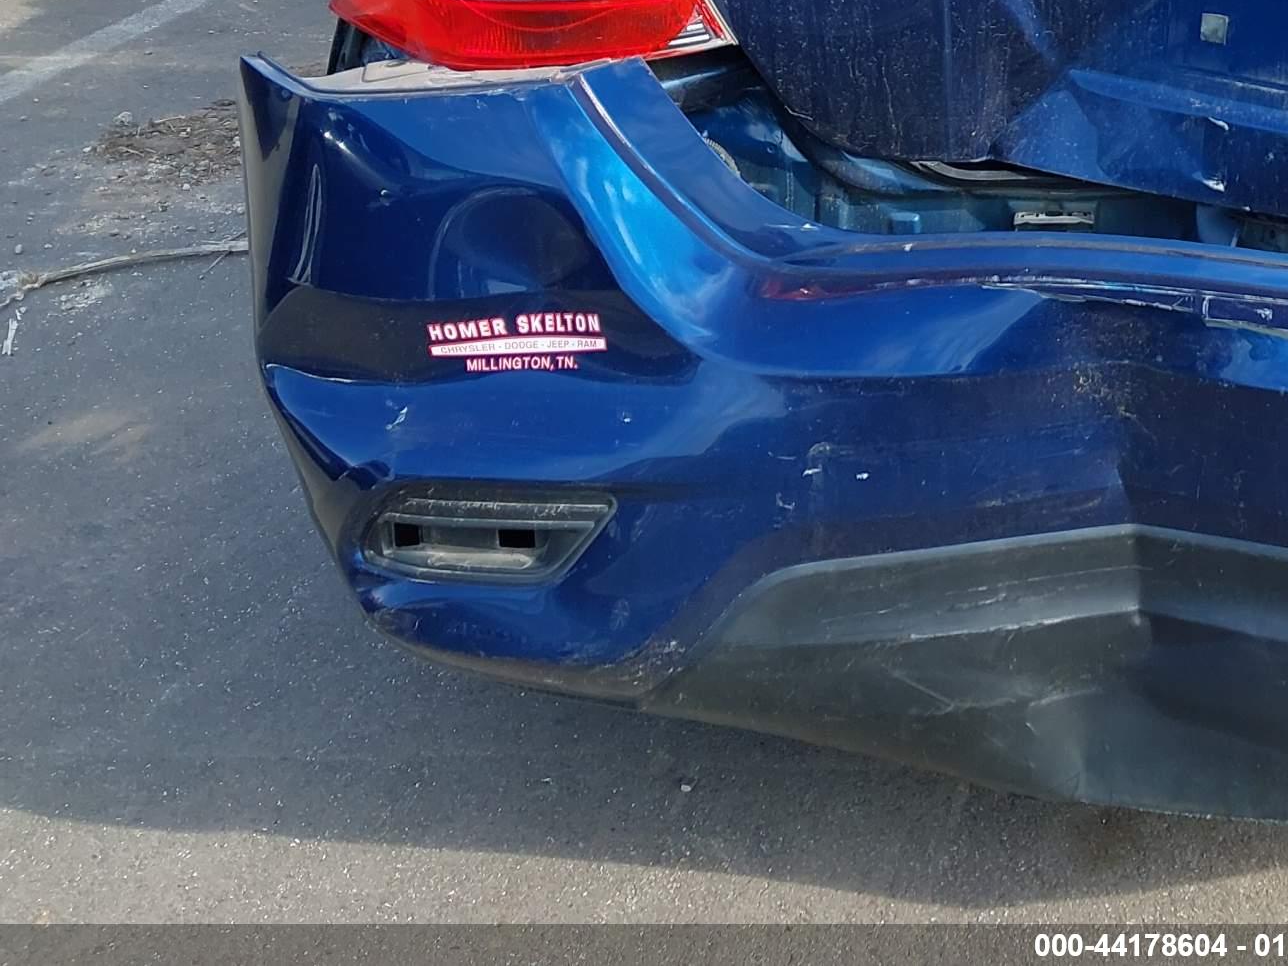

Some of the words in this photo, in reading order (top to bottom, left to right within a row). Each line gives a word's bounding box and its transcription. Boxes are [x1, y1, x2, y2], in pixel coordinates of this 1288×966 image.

[427, 317, 508, 341] HOMER
[515, 312, 601, 334] SKELTON
[440, 343, 496, 354] CHRYSLER
[504, 340, 539, 350] DODGE
[546, 339, 570, 349] JEEP
[576, 338, 598, 348] RAM
[466, 356, 555, 372] MILLINGTON,
[556, 355, 579, 370] TN.
